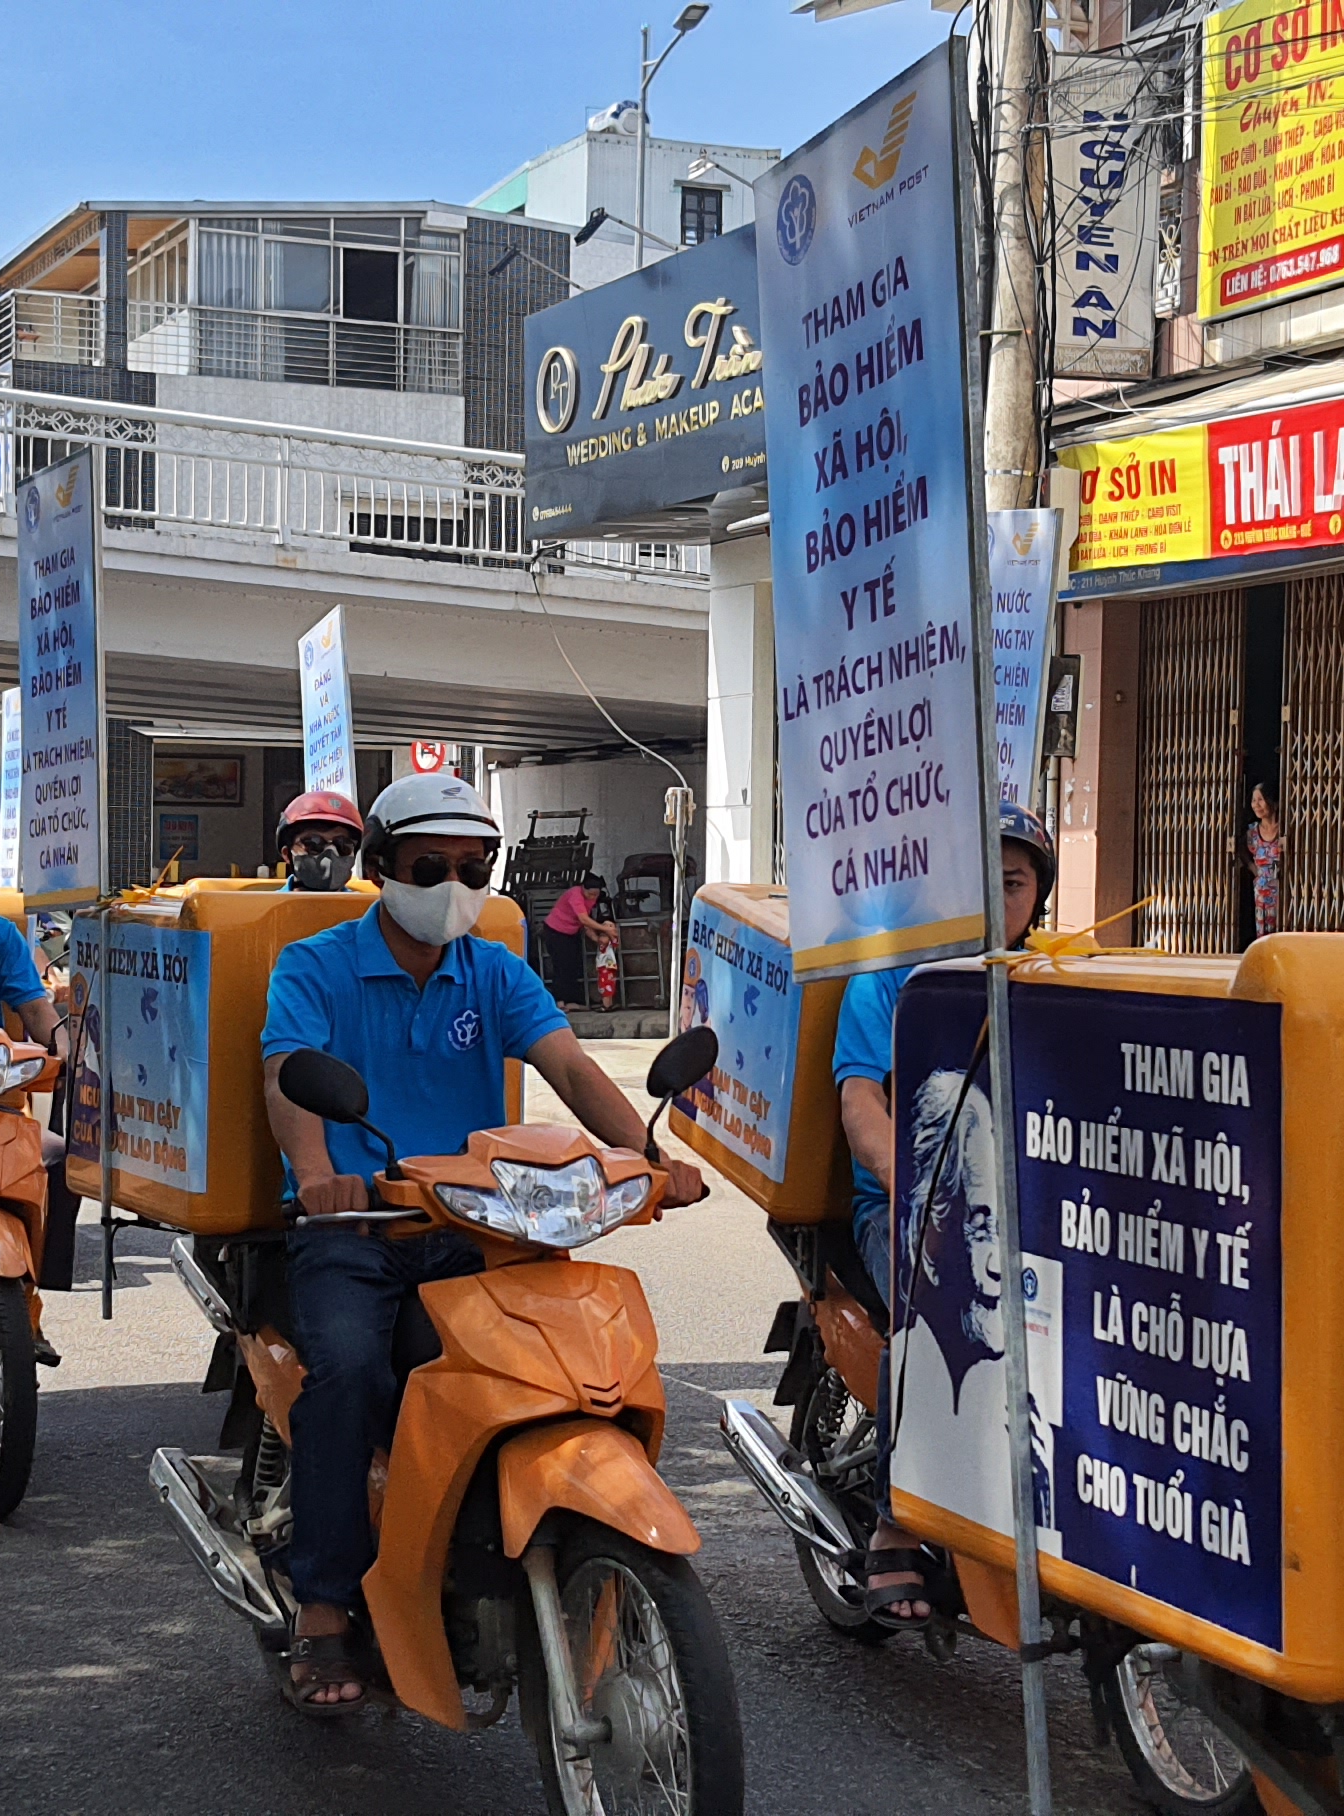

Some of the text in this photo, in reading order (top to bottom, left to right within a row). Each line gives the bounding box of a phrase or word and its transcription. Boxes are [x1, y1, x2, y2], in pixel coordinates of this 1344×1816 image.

[1225, 18, 1264, 91] CƠ
[848, 165, 929, 228] VIETNAM POST
[1273, 215, 1300, 246] CHẤT
[1304, 210, 1327, 237] LIỆU
[801, 254, 910, 350] THAM GIA
[1226, 271, 1248, 297] LIÊN
[797, 314, 925, 428] BẢO HIỂM
[566, 400, 720, 467] WEDDING & MAKEUP
[813, 407, 910, 494] XÃ HỘI,
[1218, 419, 1301, 525] THÁI
[1081, 452, 1177, 505] Ơ SỞ IN
[60, 546, 76, 569] GIA
[806, 467, 929, 575] BẢO HIỂM
[840, 555, 897, 632] Y TẾ
[782, 620, 966, 722] LÀ TRÁCH NHIỆM,
[1012, 629, 1034, 652] TAY
[819, 696, 932, 775] QUYỀN LỢI
[806, 760, 951, 841] CỦA TỔ CHỨC,
[831, 834, 929, 896] CÁ NHÂN
[162, 947, 188, 991] HỘI
[765, 960, 788, 997] HỘI
[1121, 1041, 1250, 1108] THAM GIA
[1025, 1098, 1250, 1206] BẢO HIỂM XÃ HỘI,
[1060, 1187, 1252, 1291] BẢO HIỂM Y TẾ
[1092, 1284, 1126, 1345] LÀ
[1130, 1291, 1185, 1363] CHỖ
[1191, 1317, 1250, 1388] DỰA
[1095, 1372, 1250, 1474] VỮNG CHẮC
[1076, 1452, 1251, 1568] CHO TUỔI GIÀ
